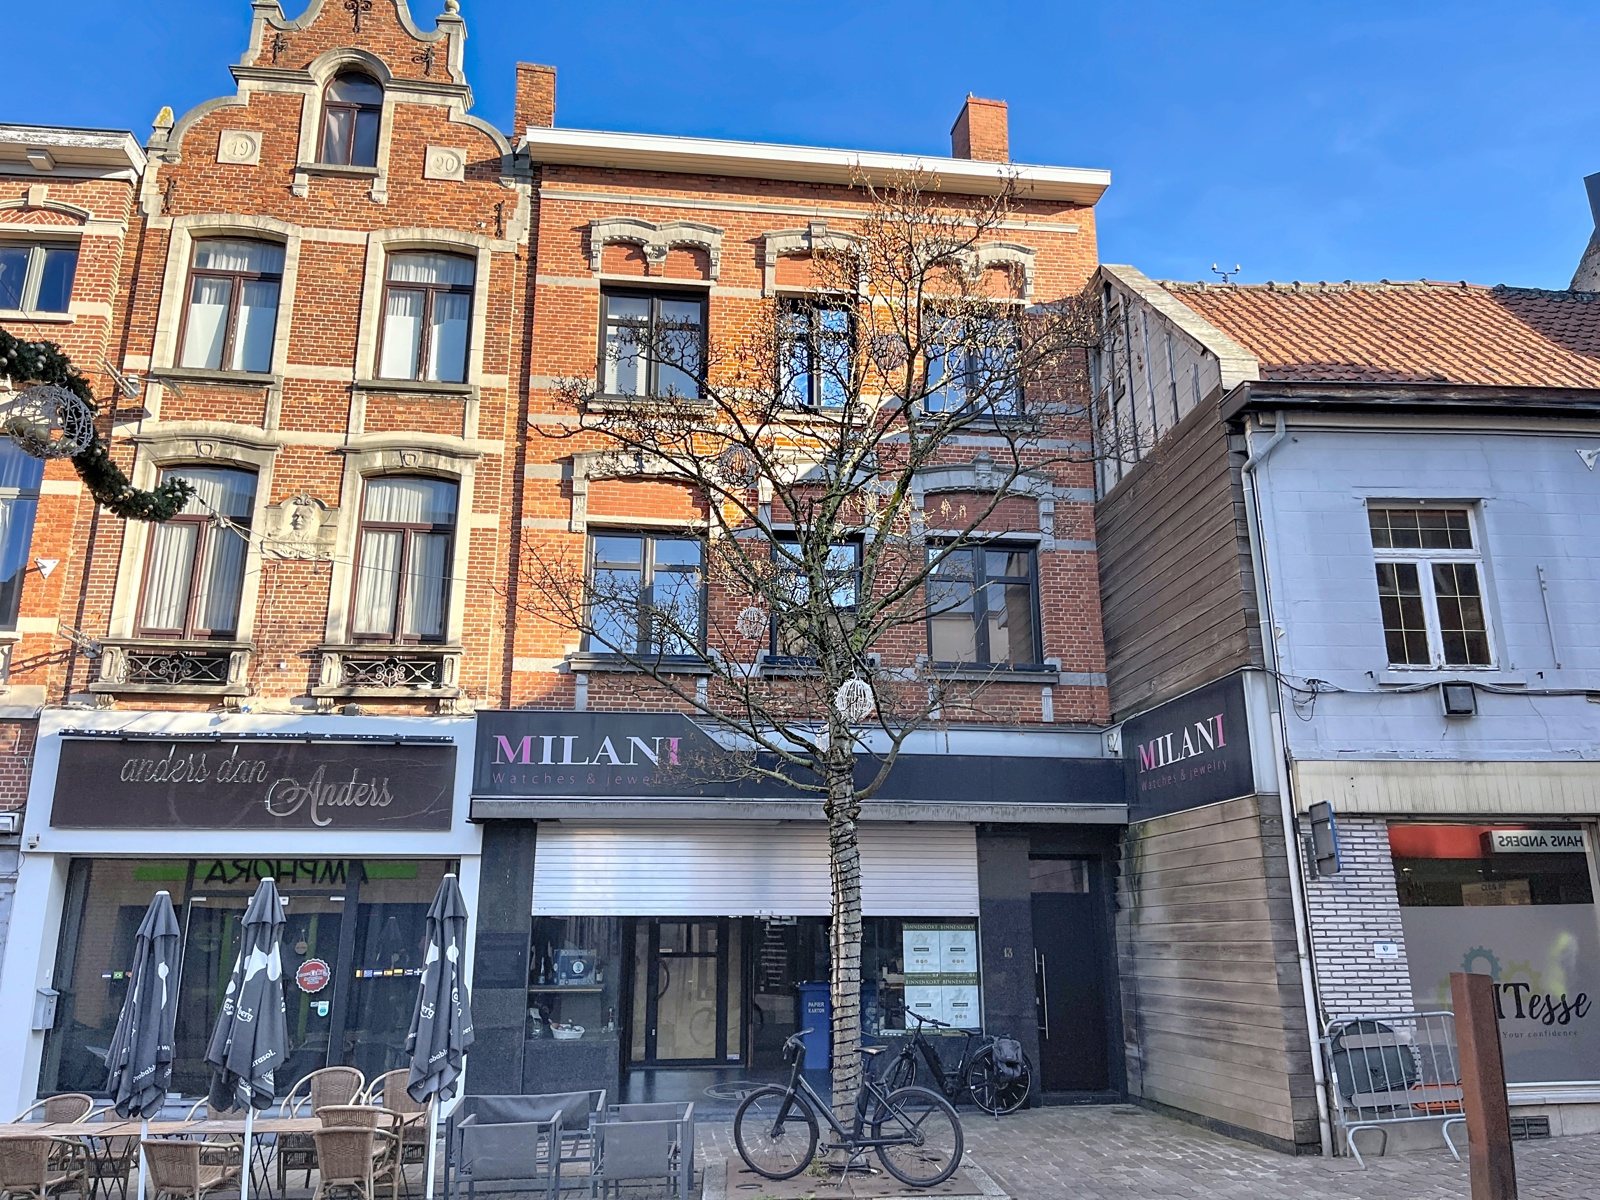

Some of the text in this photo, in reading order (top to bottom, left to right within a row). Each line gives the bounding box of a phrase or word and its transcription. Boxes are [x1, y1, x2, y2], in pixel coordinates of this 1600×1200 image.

[231, 141, 249, 156] 19
[436, 156, 455, 171] 20
[491, 735, 683, 767] MILANI
[1138, 713, 1227, 774] MILANI
[120, 744, 211, 783] anders
[1141, 773, 1177, 792] Watches
[1190, 759, 1227, 781] jewelry
[492, 772, 575, 784] Watches
[586, 773, 595, 784] &
[264, 764, 394, 827] Anders
[1003, 947, 1013, 958] 13
[1491, 983, 1592, 1025] ITesse
[1527, 1029, 1579, 1038] confidence
[132, 1064, 157, 1084] Probabl
